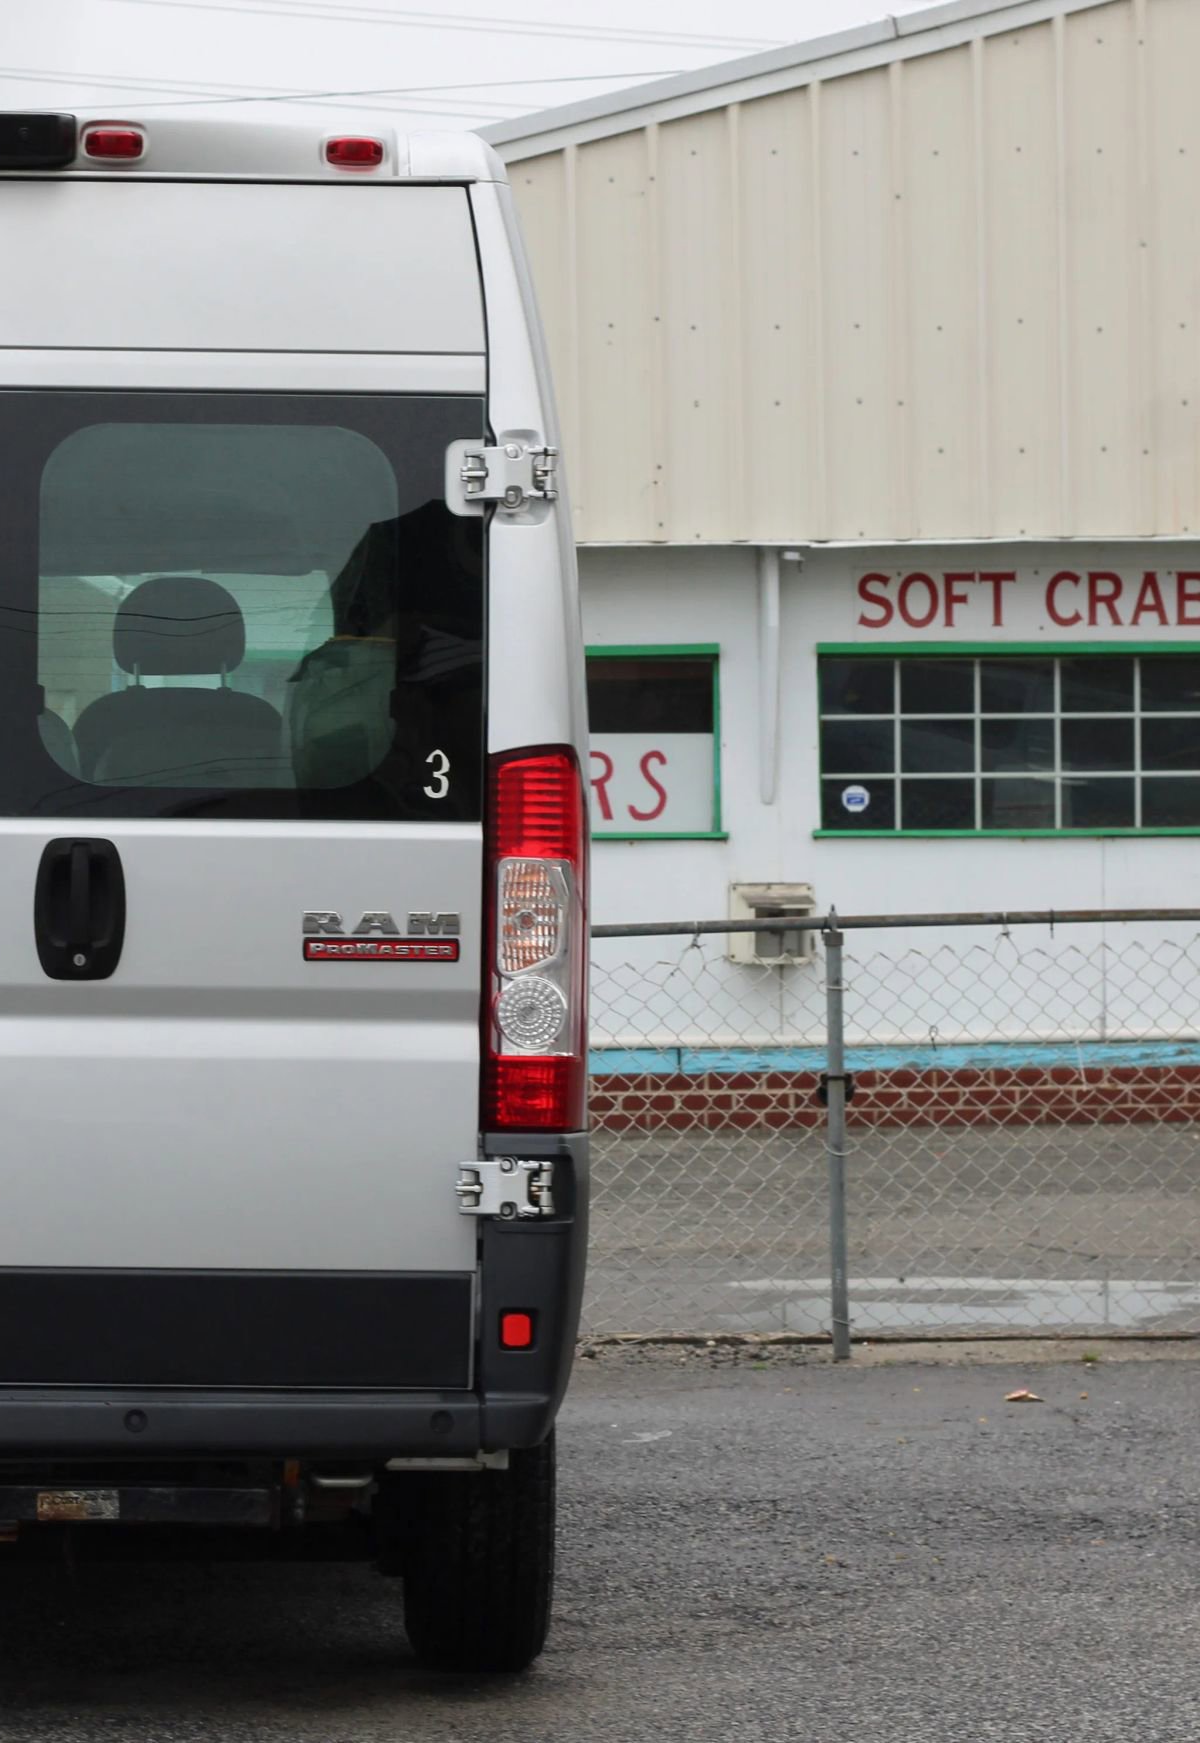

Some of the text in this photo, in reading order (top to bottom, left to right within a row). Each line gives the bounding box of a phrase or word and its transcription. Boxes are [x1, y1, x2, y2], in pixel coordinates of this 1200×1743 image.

[857, 571, 1017, 629] SOFT
[423, 749, 451, 799] 3
[302, 910, 461, 935] RAM
